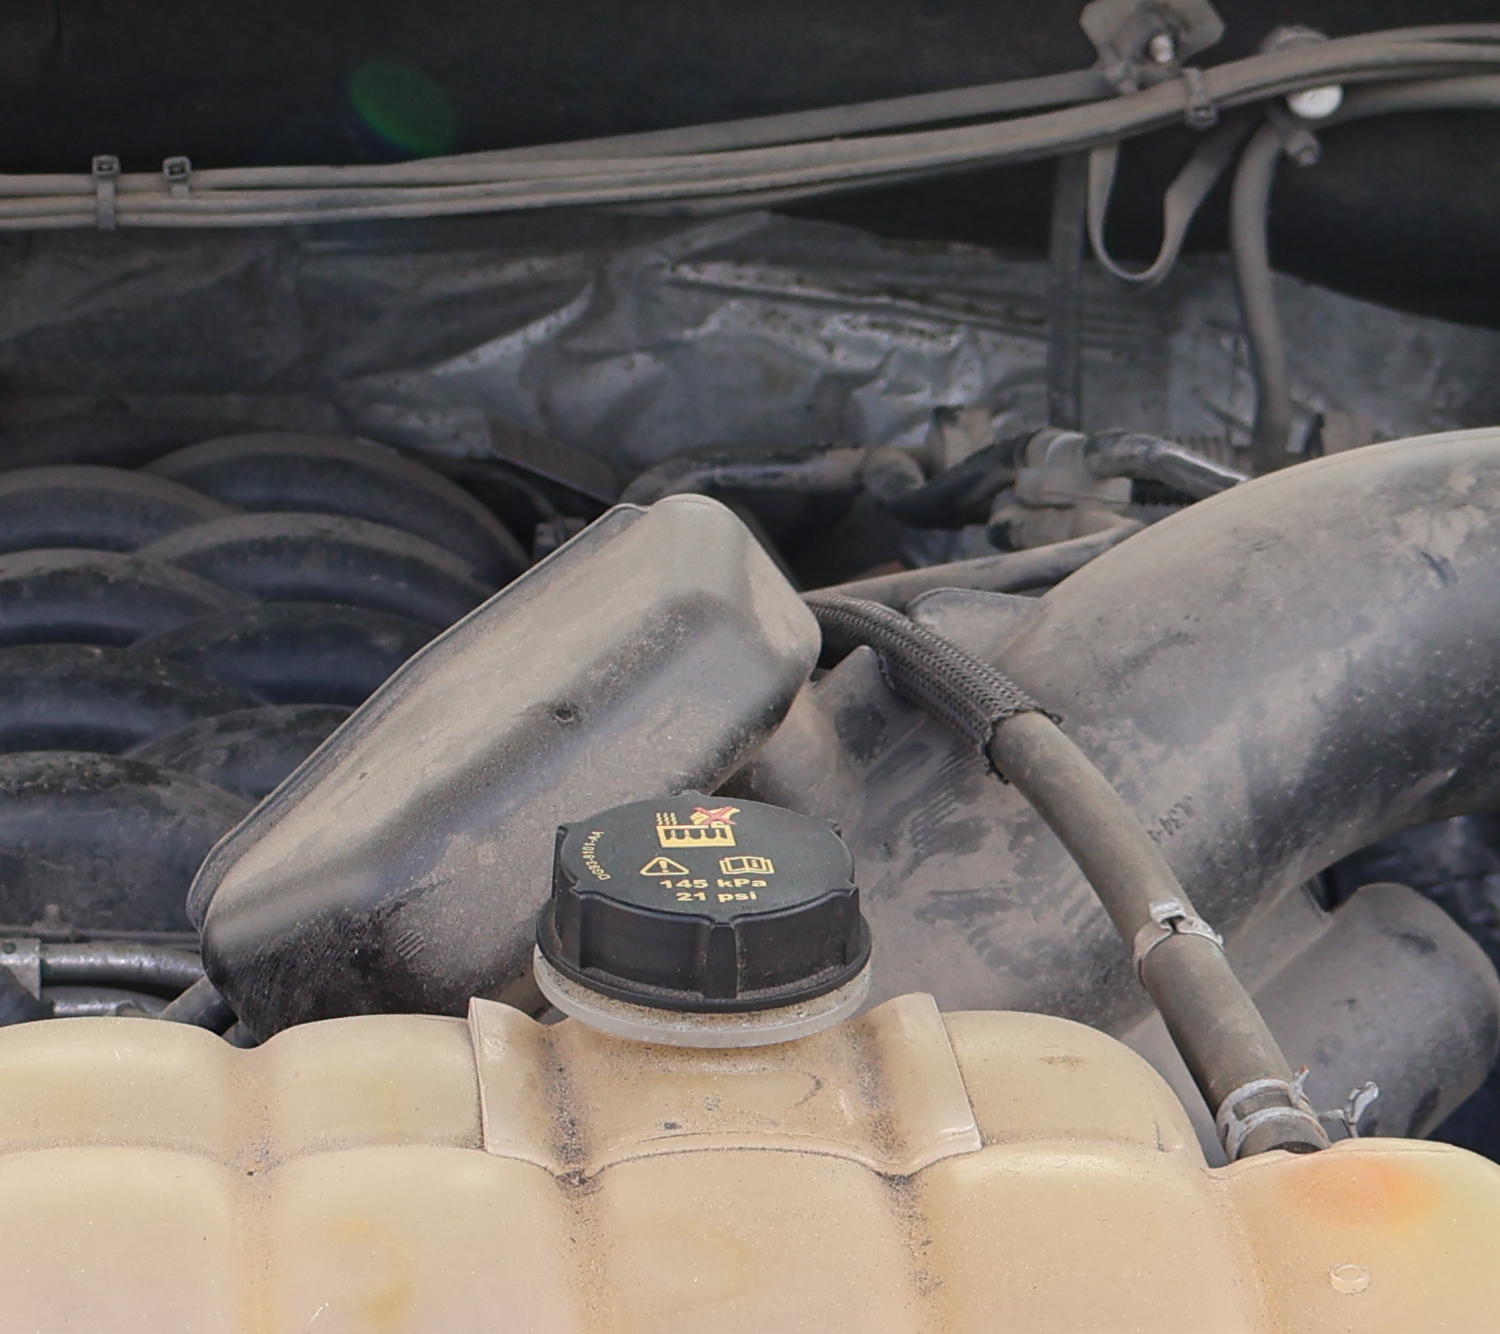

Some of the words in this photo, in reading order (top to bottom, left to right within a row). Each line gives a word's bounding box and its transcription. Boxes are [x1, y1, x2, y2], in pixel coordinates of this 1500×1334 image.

[660, 879, 709, 889] 145
[717, 878, 767, 888] kPa
[675, 892, 707, 902] 21
[717, 890, 757, 903] psi
